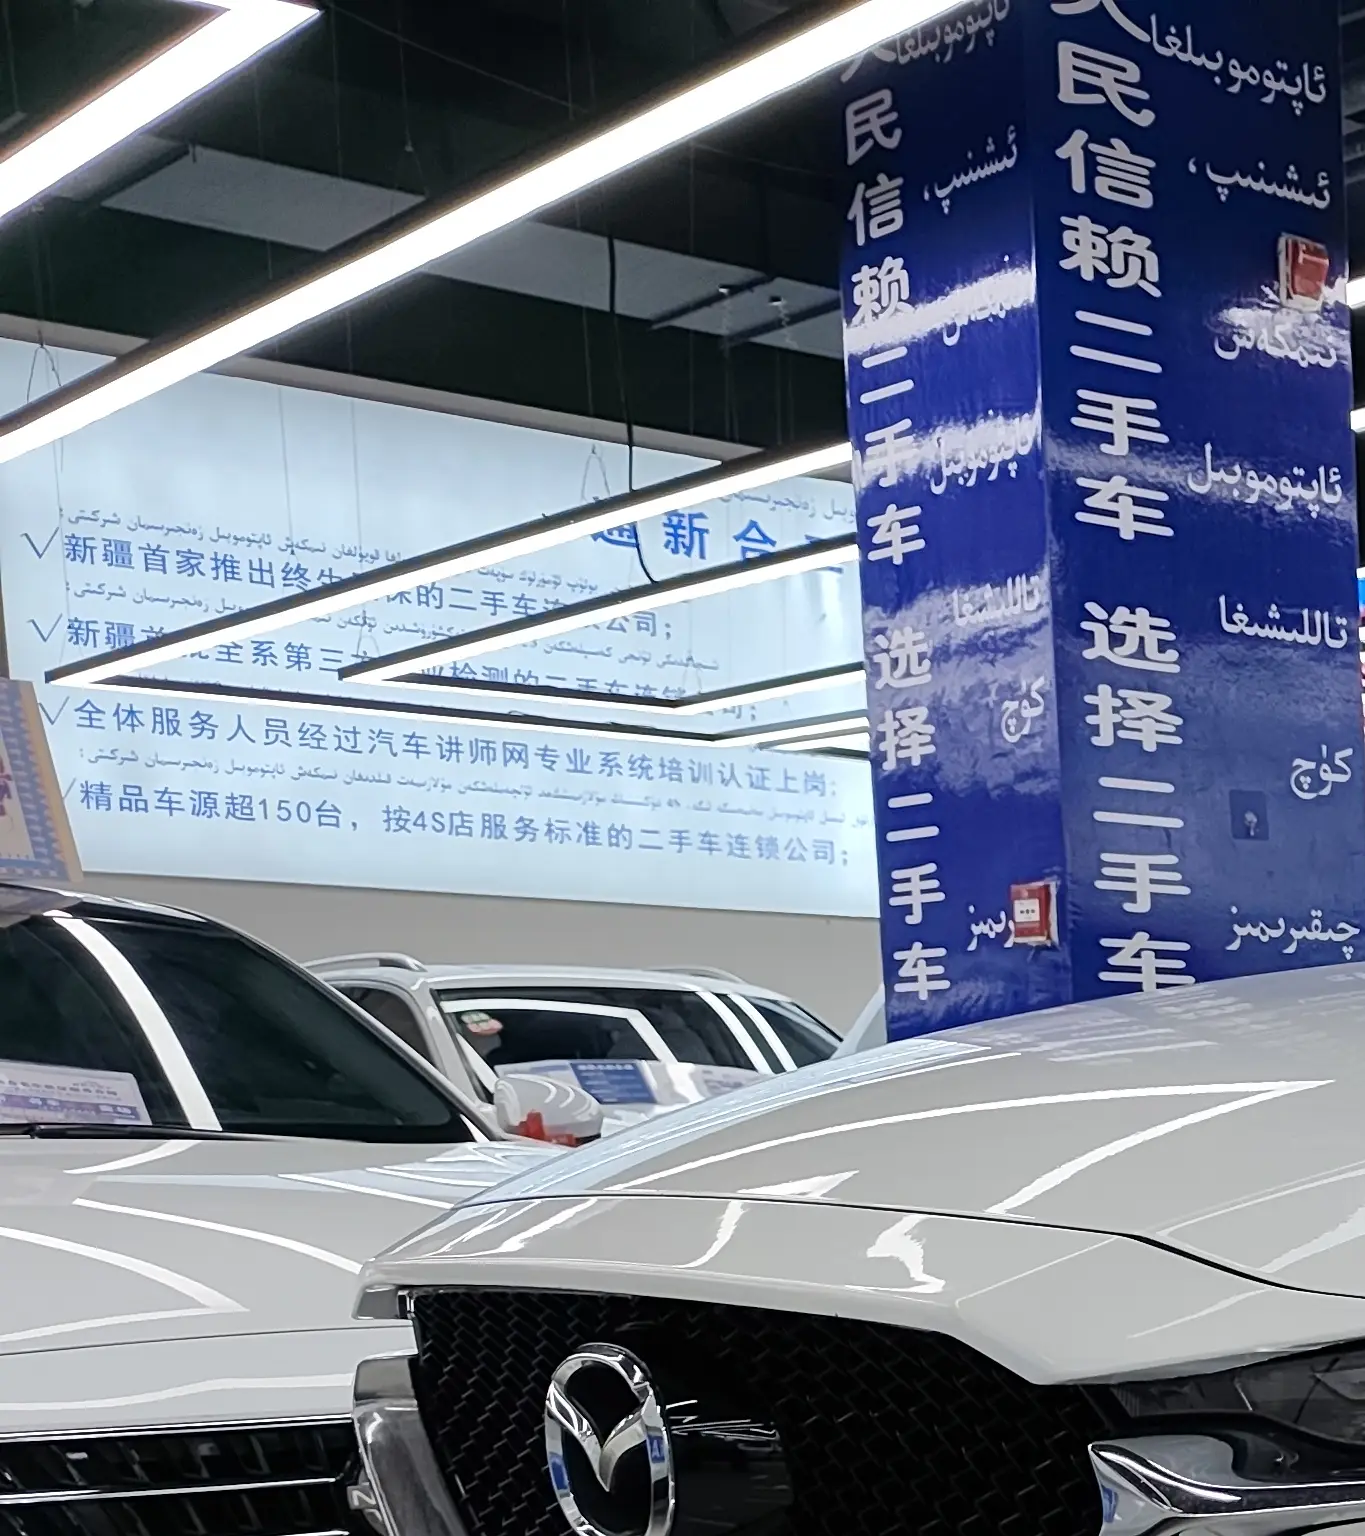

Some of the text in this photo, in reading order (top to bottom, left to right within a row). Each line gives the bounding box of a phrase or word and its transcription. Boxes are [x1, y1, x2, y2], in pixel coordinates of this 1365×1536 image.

[873, 626, 950, 1000] 选择二手车
[1081, 602, 1196, 992] 选择二手车
